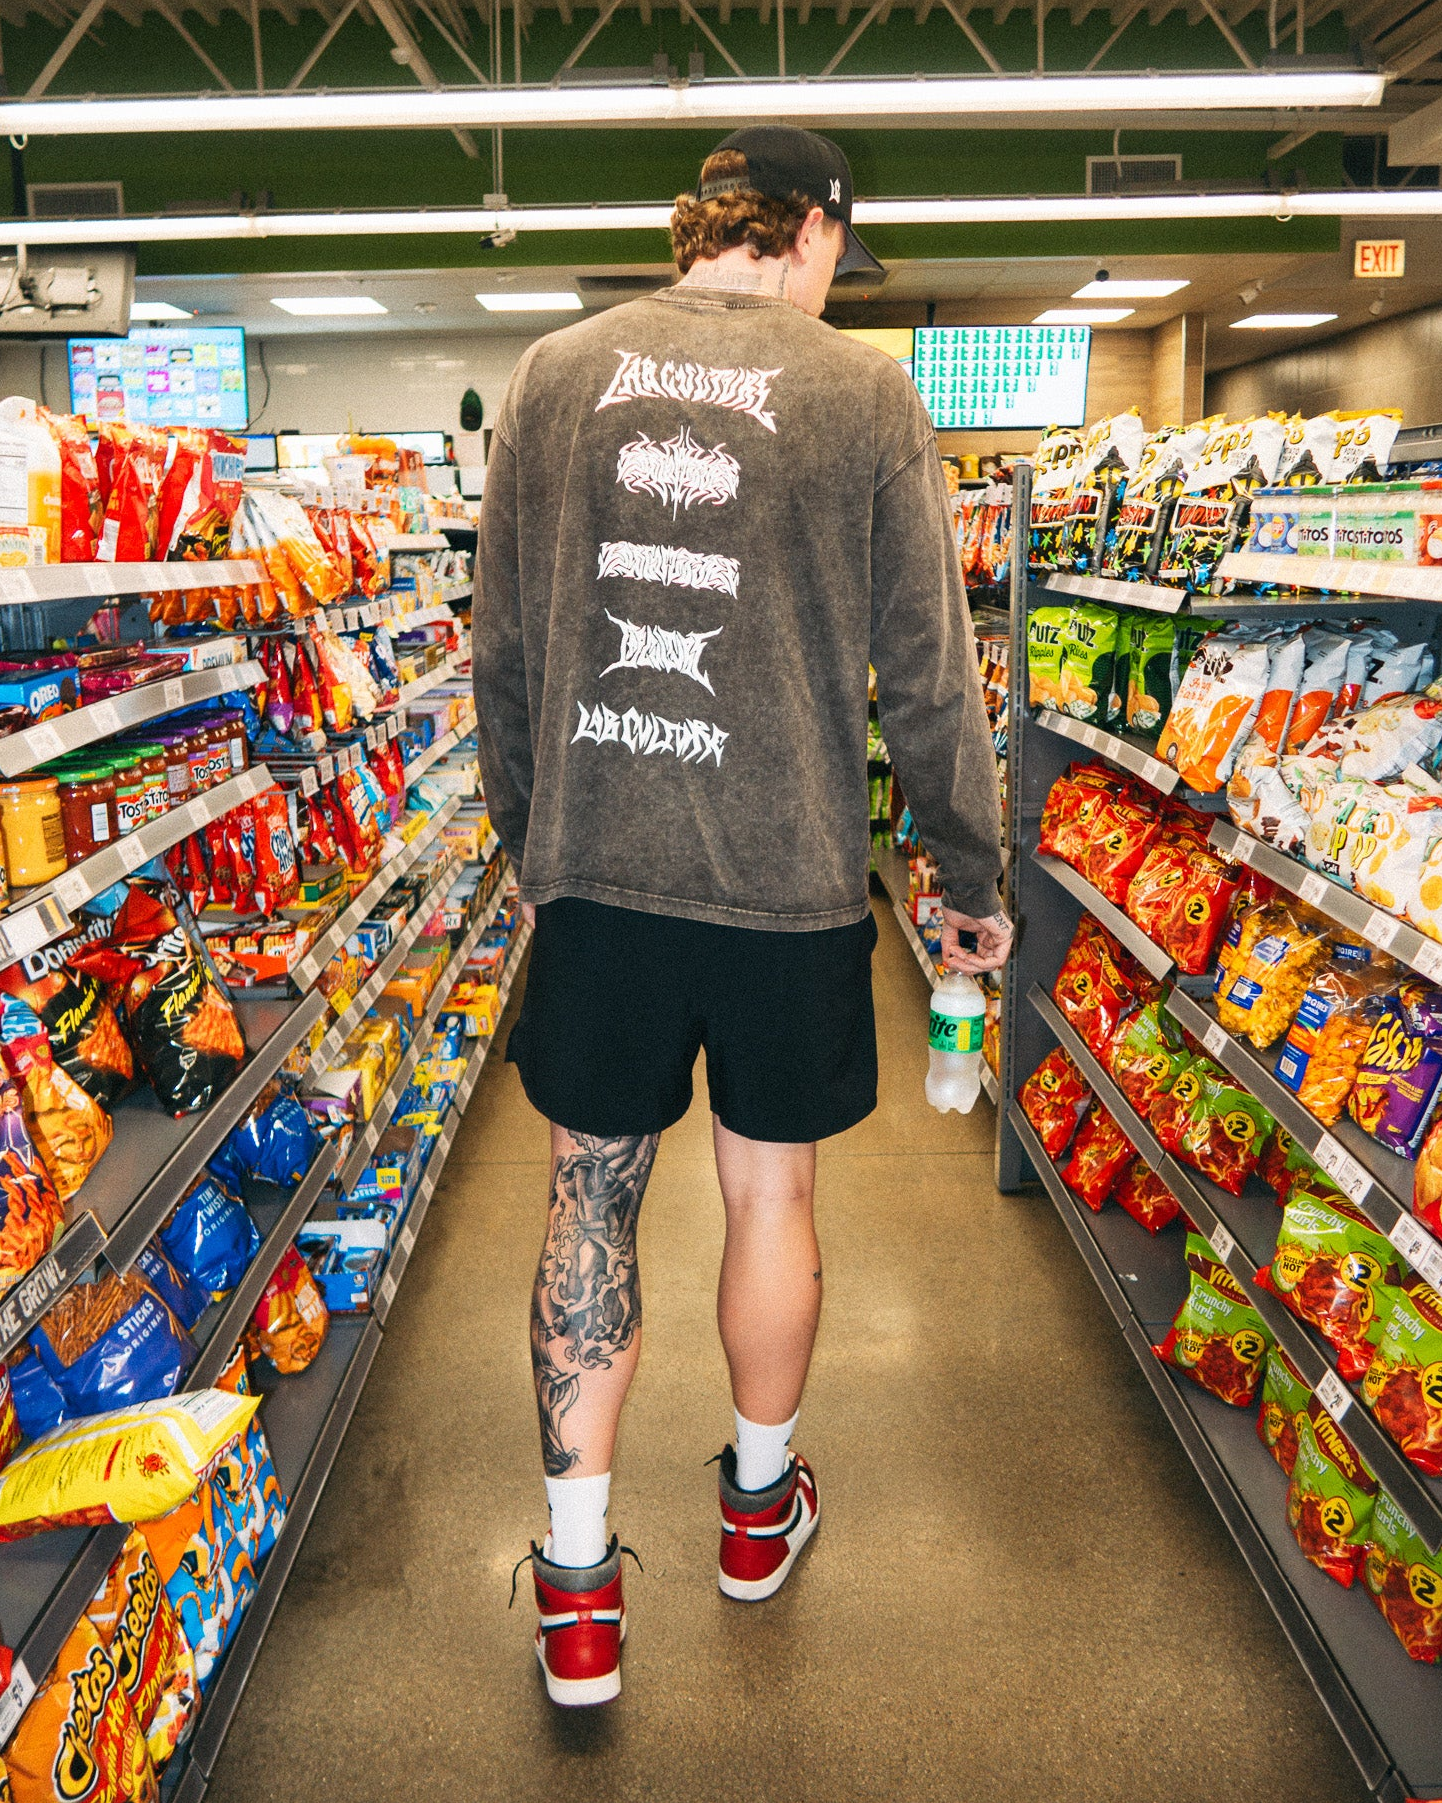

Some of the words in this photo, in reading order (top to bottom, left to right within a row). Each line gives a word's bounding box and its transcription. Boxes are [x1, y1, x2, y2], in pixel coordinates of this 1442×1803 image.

[1361, 245, 1399, 272] EXIT
[660, 360, 785, 435] CULTURE
[29, 683, 60, 715] OREO
[570, 700, 621, 746] LAB
[621, 706, 730, 767] CULTURE
[1186, 902, 1205, 921] $2
[930, 1014, 957, 1038] rite
[1175, 1080, 1193, 1099] $2
[1226, 1120, 1249, 1139] $2
[1235, 1114, 1251, 1123] ONLY
[198, 1186, 215, 1205] TINY
[199, 1192, 226, 1222] TWISTS
[1297, 1200, 1348, 1230] Crunchy
[137, 1250, 153, 1269] CKS
[149, 1261, 164, 1278] INAL
[1282, 1263, 1302, 1273] HOT
[1358, 1257, 1377, 1269] ONLY
[0, 1301, 22, 1342] HE
[18, 1256, 67, 1318] GROWL
[1187, 1295, 1216, 1321] Kurls
[1193, 1284, 1234, 1316] Crunchy
[117, 1299, 155, 1340] STICKS
[123, 1311, 165, 1355] ORIGINAL
[1391, 1303, 1426, 1342] runchy
[1234, 1339, 1260, 1360] $2
[1312, 1409, 1358, 1478] VITNER'S
[1323, 1506, 1345, 1535] $2
[1375, 1505, 1398, 1536] urls
[1379, 1492, 1418, 1539] runchy
[1411, 1575, 1437, 1605] $2
